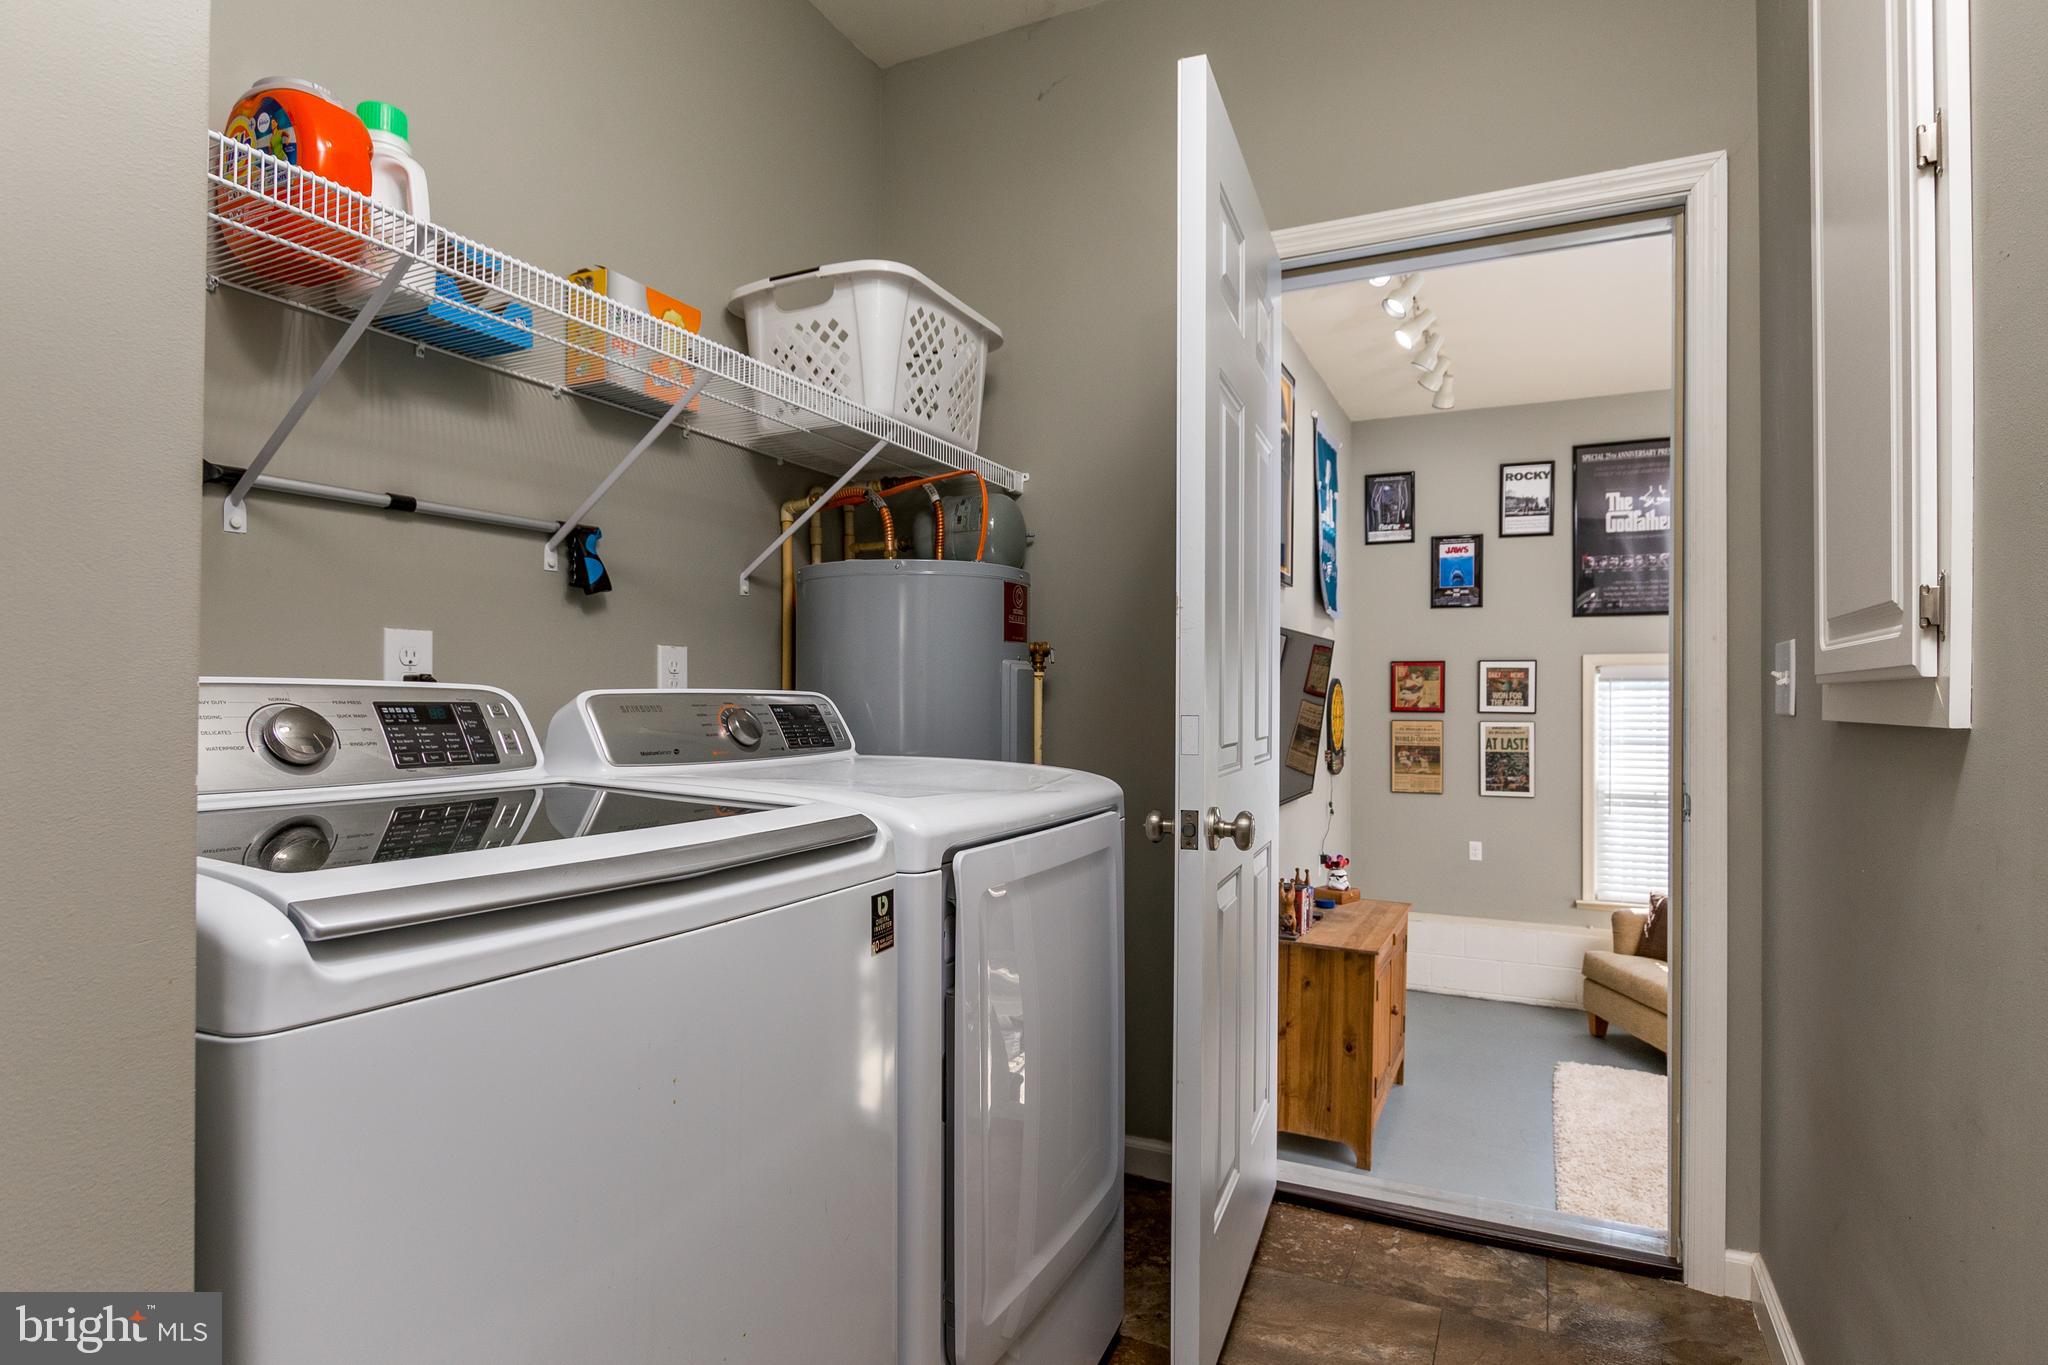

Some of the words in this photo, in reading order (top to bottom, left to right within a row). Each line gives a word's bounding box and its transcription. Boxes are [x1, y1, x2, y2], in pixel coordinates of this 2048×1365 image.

[1582, 453, 1604, 463] SPECIAL
[1617, 449, 1656, 459] ANNIVERSARY
[1505, 471, 1550, 481] ROCKY
[1605, 492, 1633, 512] The
[1445, 546, 1469, 554] JAWS
[1486, 738, 1497, 750] AT
[1501, 738, 1528, 750] LAST!
